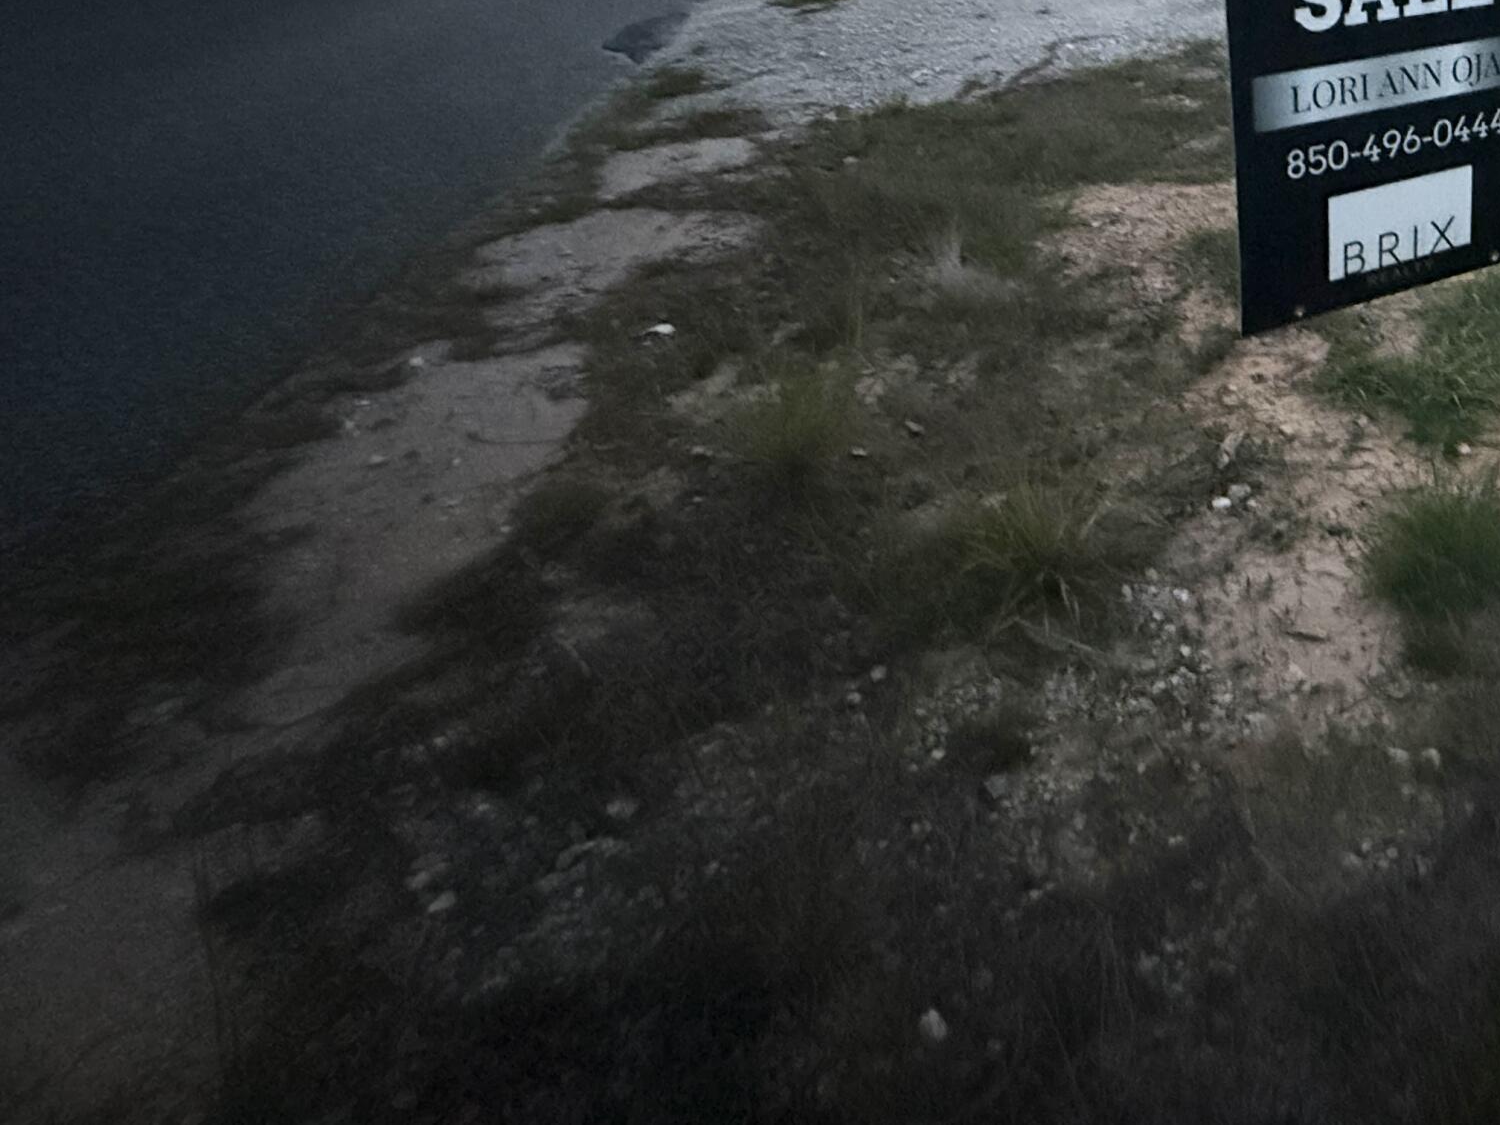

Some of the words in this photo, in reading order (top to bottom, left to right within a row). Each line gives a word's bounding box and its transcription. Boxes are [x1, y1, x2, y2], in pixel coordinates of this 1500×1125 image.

[1291, 73, 1370, 114] LORI
[1379, 59, 1443, 99] ANN
[1343, 215, 1456, 277] BRIX
